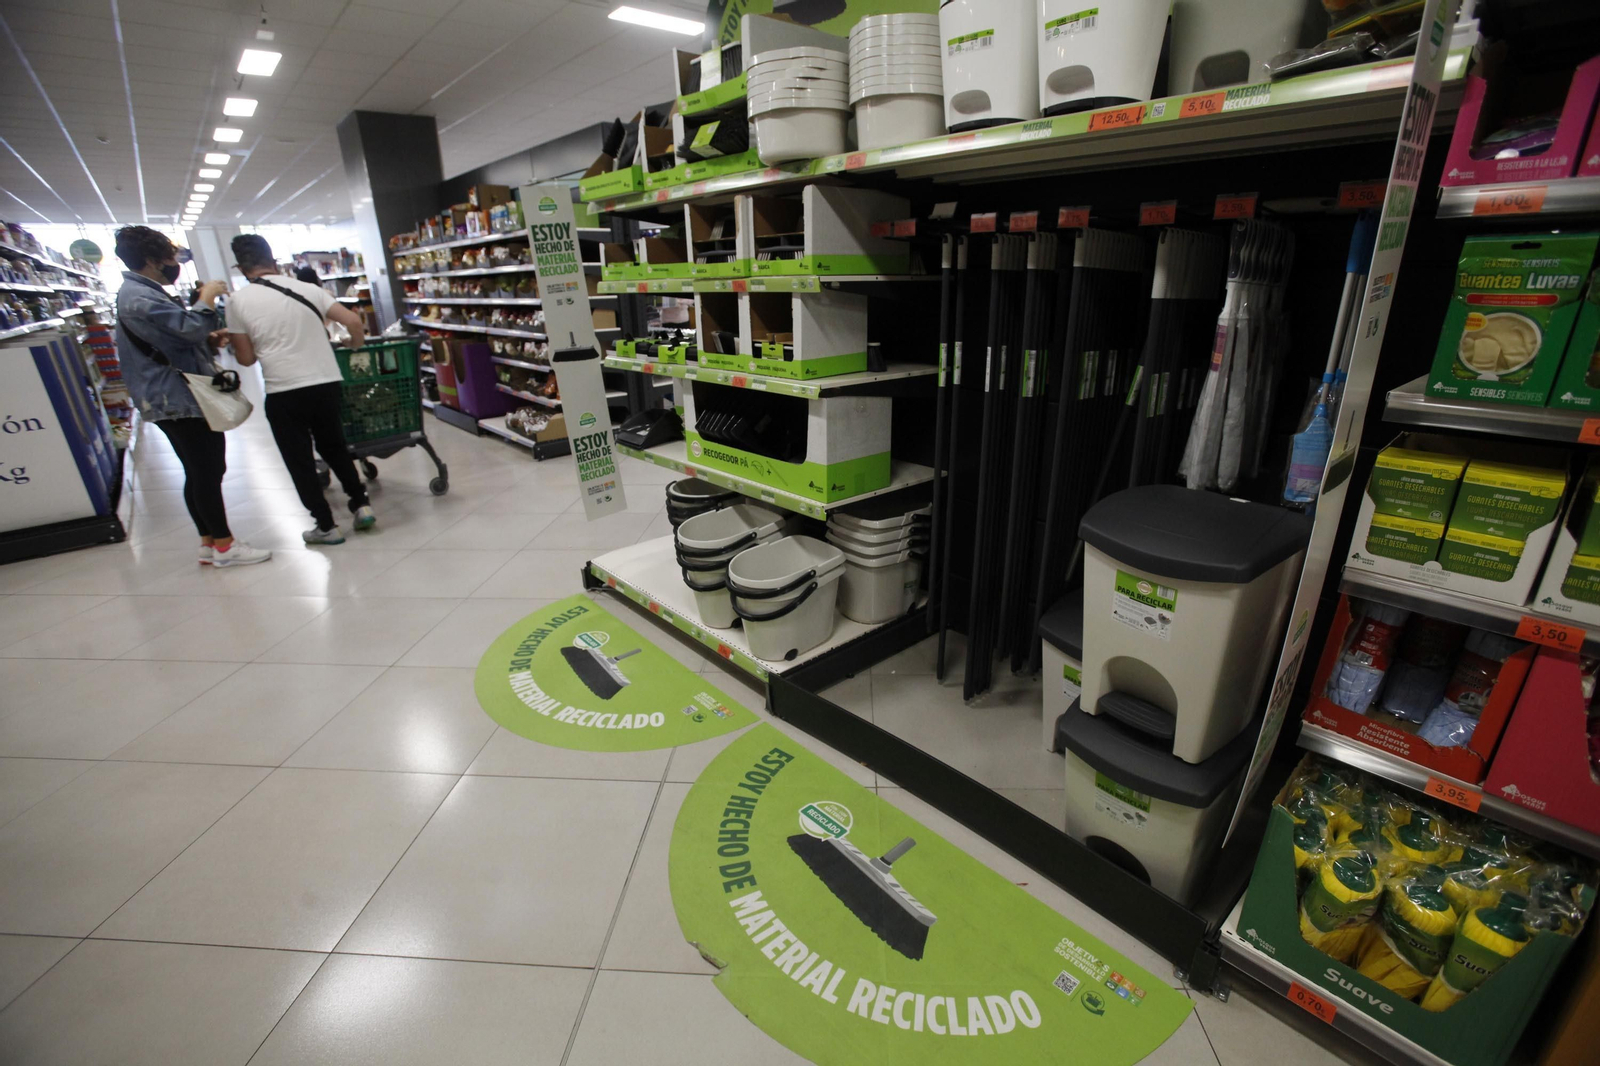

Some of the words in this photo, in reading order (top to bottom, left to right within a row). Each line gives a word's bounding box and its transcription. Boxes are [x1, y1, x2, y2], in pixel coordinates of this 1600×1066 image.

[721, 2, 741, 44] STOY
[1225, 83, 1272, 100] MATERIAL
[1222, 96, 1270, 111] RECICLADO
[1020, 129, 1052, 141] RECICLADO
[1022, 120, 1053, 132] MATERIAL
[531, 222, 571, 242] ESTOY
[534, 241, 562, 254] HECHO
[564, 240, 575, 252] DE
[537, 253, 577, 266] MATERIAL
[539, 263, 579, 277] RECICLADO
[1459, 272, 1522, 290] Guantes
[1526, 272, 1580, 290] Luvas
[1470, 386, 1506, 399] SENSIBLES
[573, 431, 608, 453] ESTOY
[576, 449, 600, 463] HECHO
[602, 445, 612, 456] DE
[703, 447, 739, 465] RECOGEDOR
[740, 457, 749, 468] PÁ
[578, 456, 614, 473] MATERIAL
[580, 465, 615, 482] RECICLADO
[1379, 479, 1403, 489] GUANTES
[1405, 482, 1445, 495] DESECHABLES
[1467, 494, 1496, 507] GUANTES
[1497, 500, 1545, 514] DESECHABLES
[1389, 540, 1429, 554] DESECHABLES
[1449, 552, 1477, 565] GUANTES
[1477, 559, 1514, 573] DESECHABL
[1117, 585, 1135, 598] PARA
[1136, 593, 1173, 611] RECICLAR
[545, 605, 590, 632] ESTOY
[514, 628, 553, 657] HECHO
[1531, 625, 1568, 642] 3,50
[509, 657, 532, 673] DE
[509, 670, 562, 717] MATERIAL
[553, 705, 665, 730] RECICLADO
[1360, 725, 1410, 749] Resistente
[1369, 722, 1405, 740] Microfibra
[1356, 731, 1410, 756] Absorbente
[738, 747, 795, 796] ESTOY
[1115, 792, 1148, 812] RECICLAR
[717, 795, 759, 857] HECHO
[807, 808, 841, 834] RECICLADO
[718, 860, 757, 894] DE
[729, 890, 846, 1004] MATERIAL
[846, 978, 1042, 1036] RECICLADO
[1054, 946, 1103, 983] SOSTENIBLE
[1323, 967, 1395, 1015] Suave
